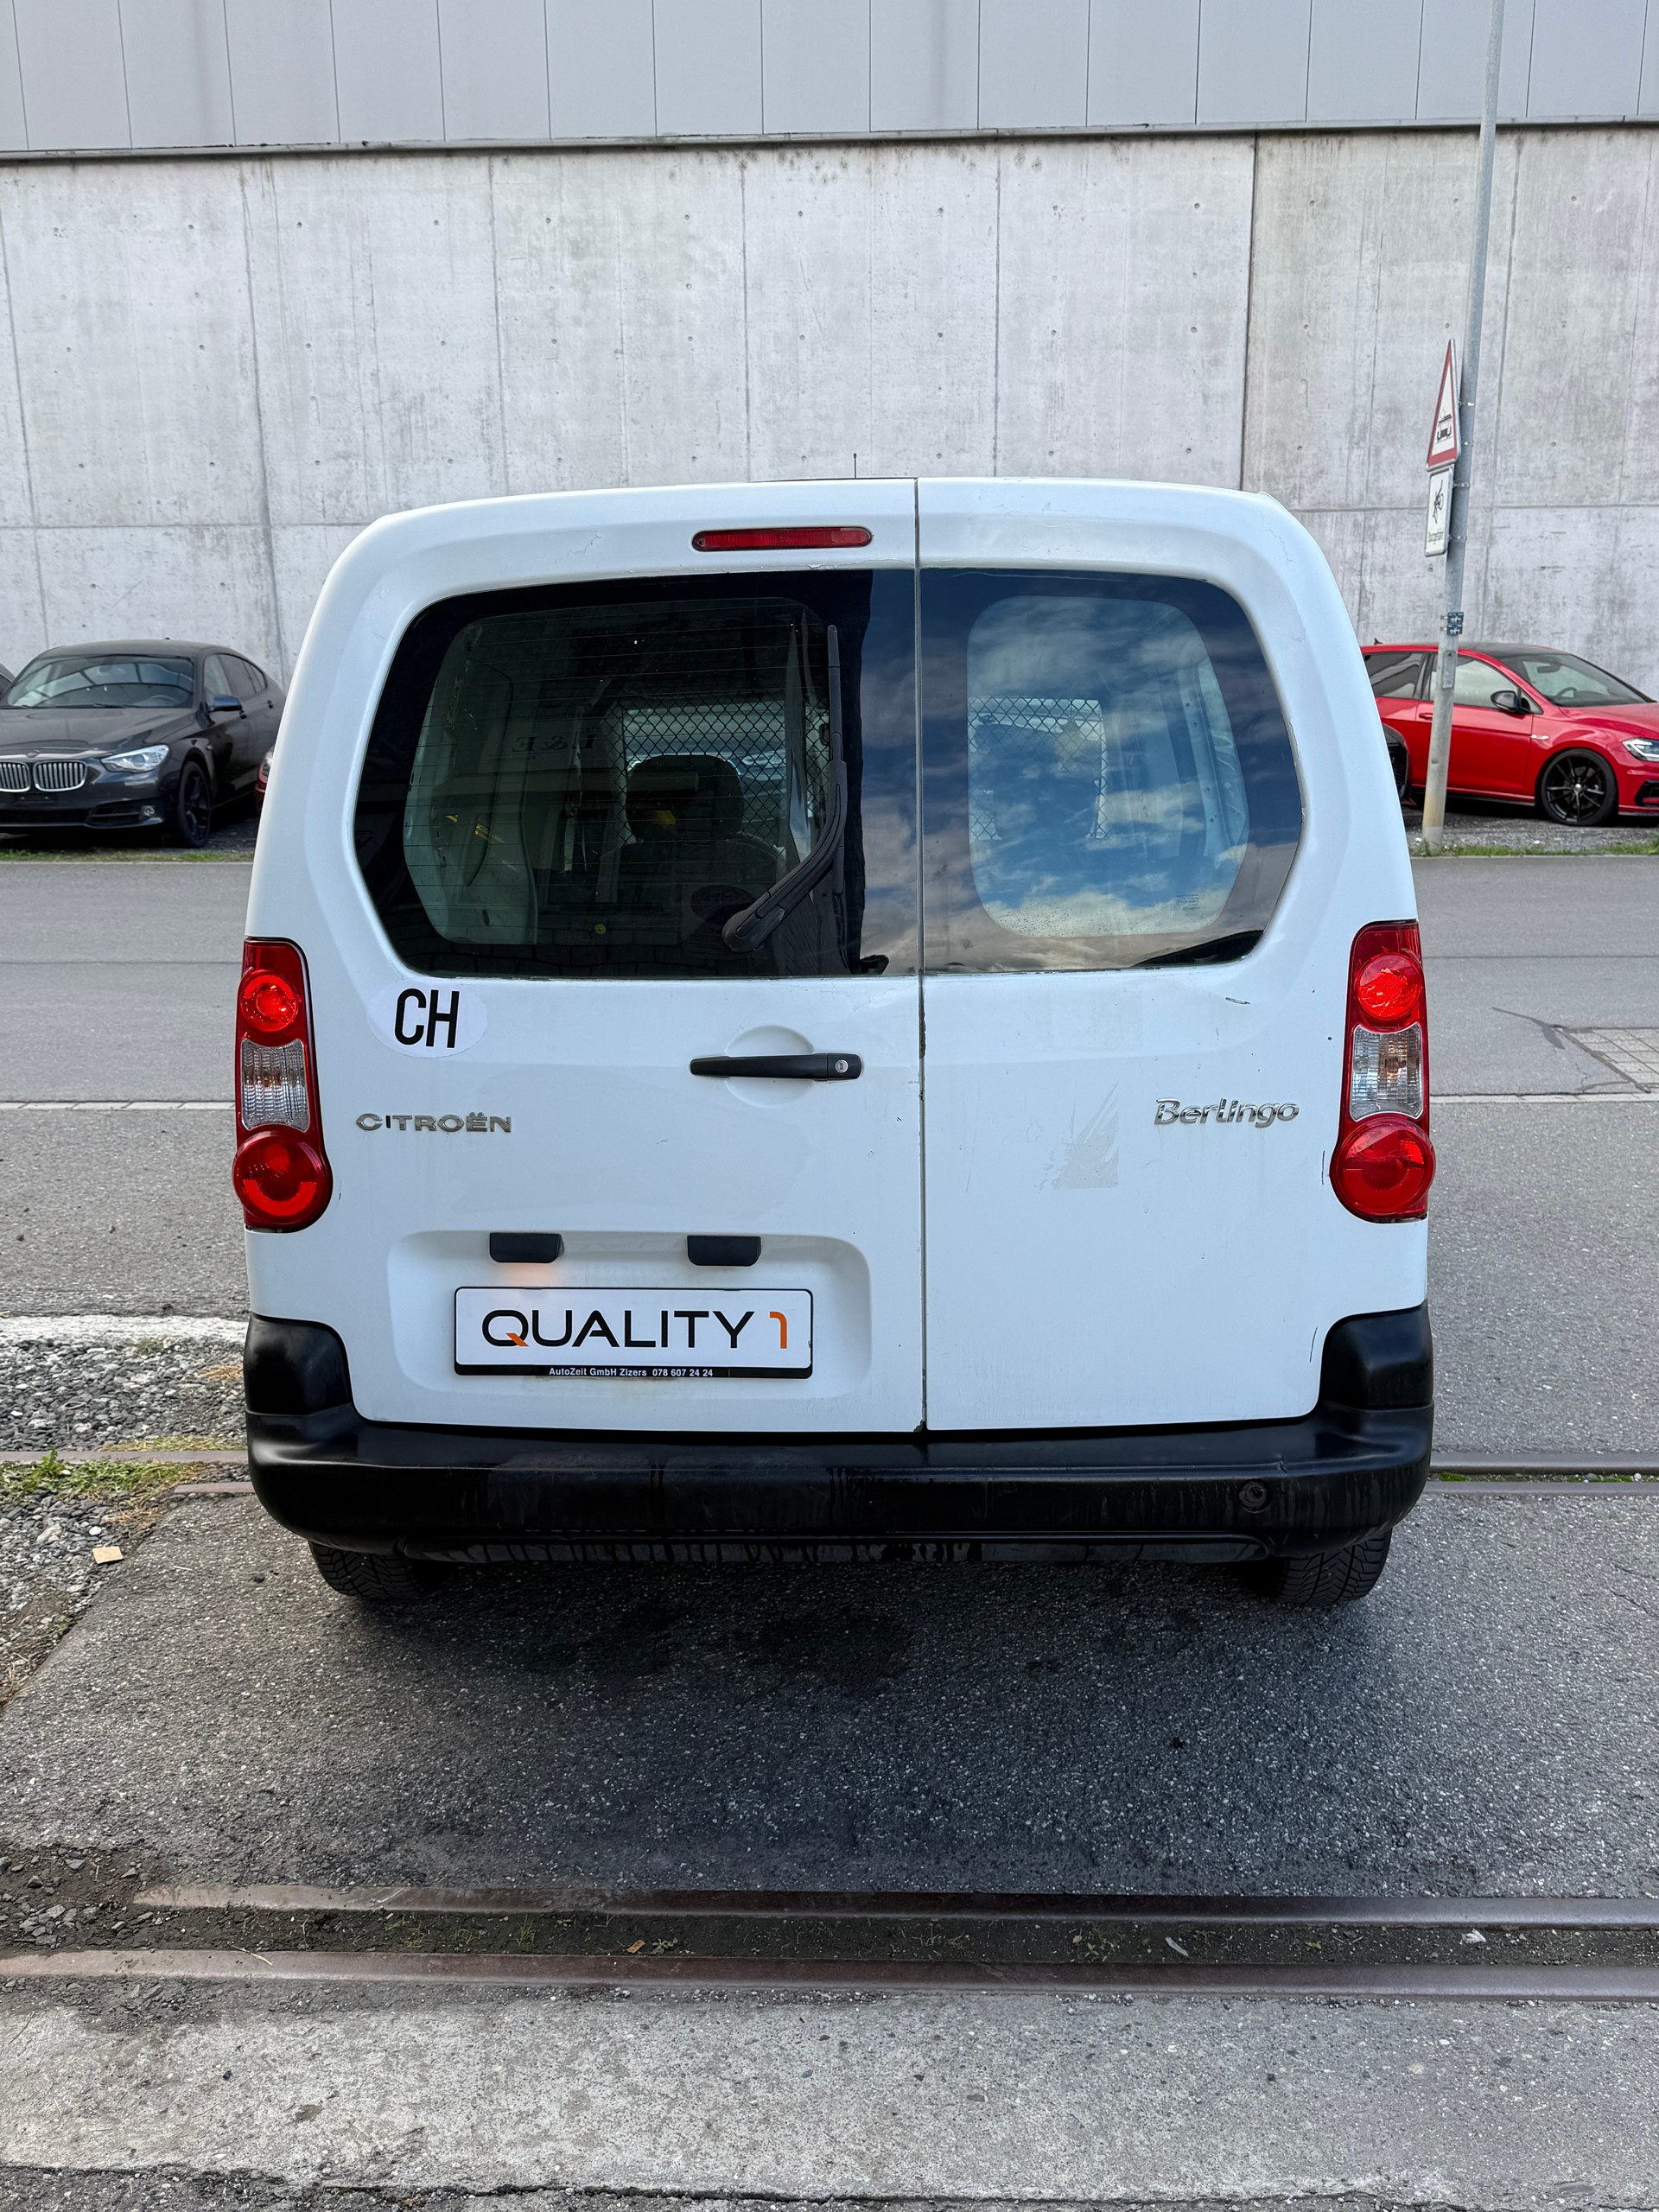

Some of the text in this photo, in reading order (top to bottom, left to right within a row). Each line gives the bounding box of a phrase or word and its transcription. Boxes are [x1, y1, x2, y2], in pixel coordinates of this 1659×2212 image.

[395, 988, 460, 1048] CH
[355, 1111, 512, 1134] CITROËN
[1154, 1097, 1300, 1128] Berlingo
[481, 1309, 788, 1349] QUALITY 1
[549, 1367, 714, 1377] AutoZeit GmbH Zizers 078 607 24 24
